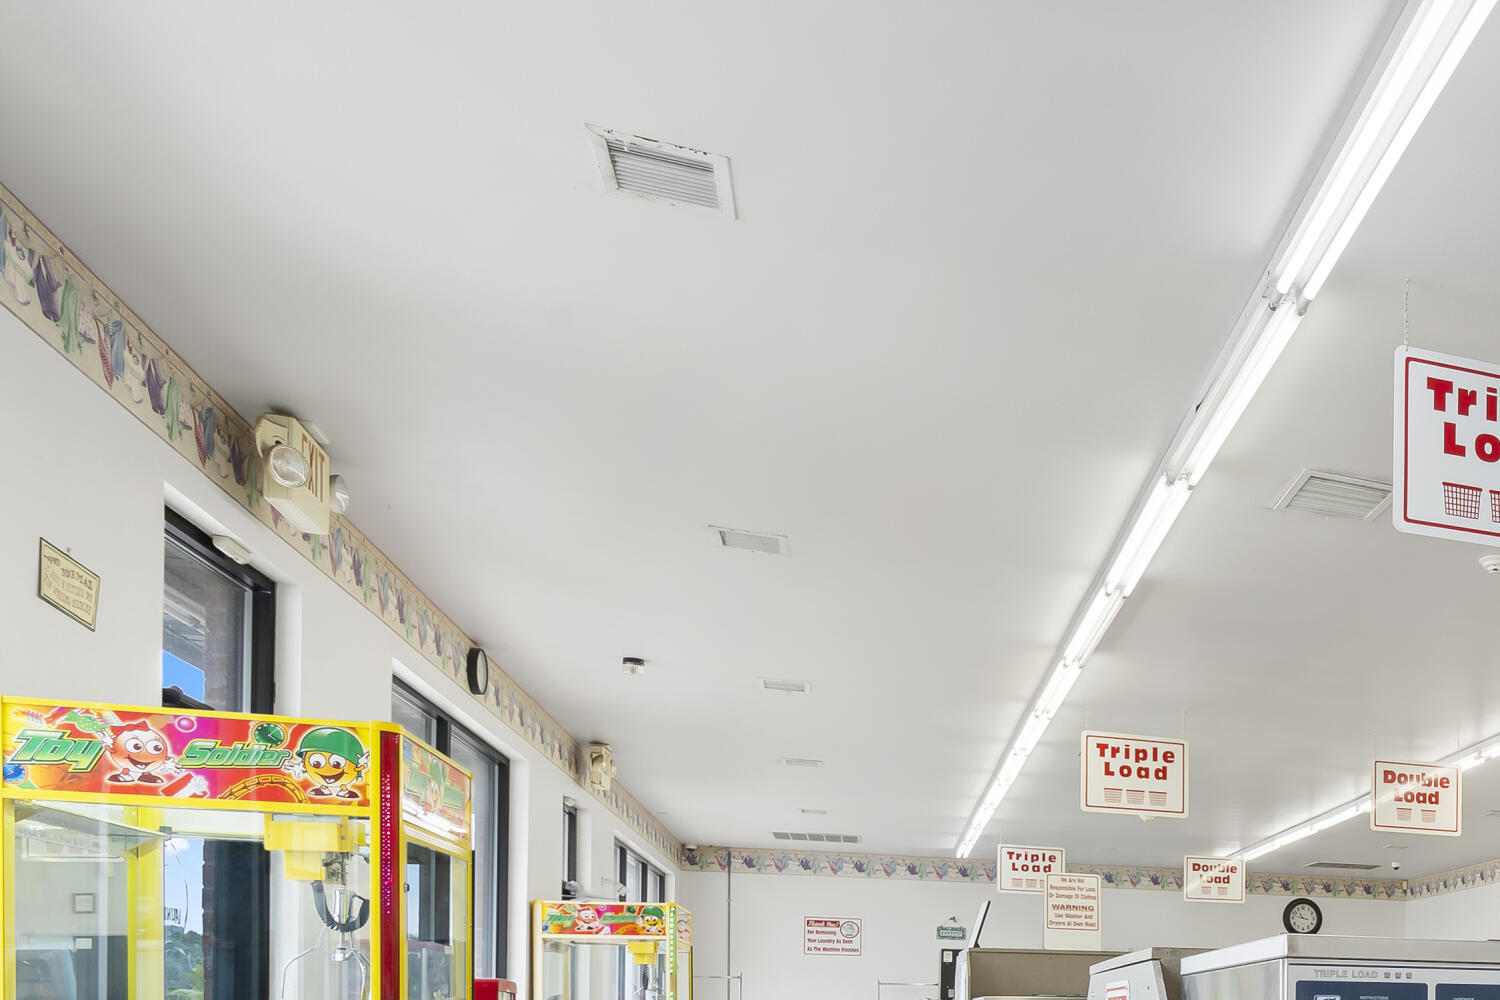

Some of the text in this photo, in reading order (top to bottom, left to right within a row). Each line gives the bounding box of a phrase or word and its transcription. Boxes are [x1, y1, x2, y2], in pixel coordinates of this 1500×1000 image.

[7, 728, 291, 772] Toy Soldier
[1096, 743, 1175, 763] Triple
[1104, 761, 1168, 781] Load
[1383, 769, 1450, 788] Double
[1393, 787, 1440, 805] Load
[1007, 851, 1057, 863] Triple
[1011, 862, 1052, 873] Load
[1051, 903, 1095, 912] WARNING
[1313, 969, 1378, 979] TRIPLE LOAD
